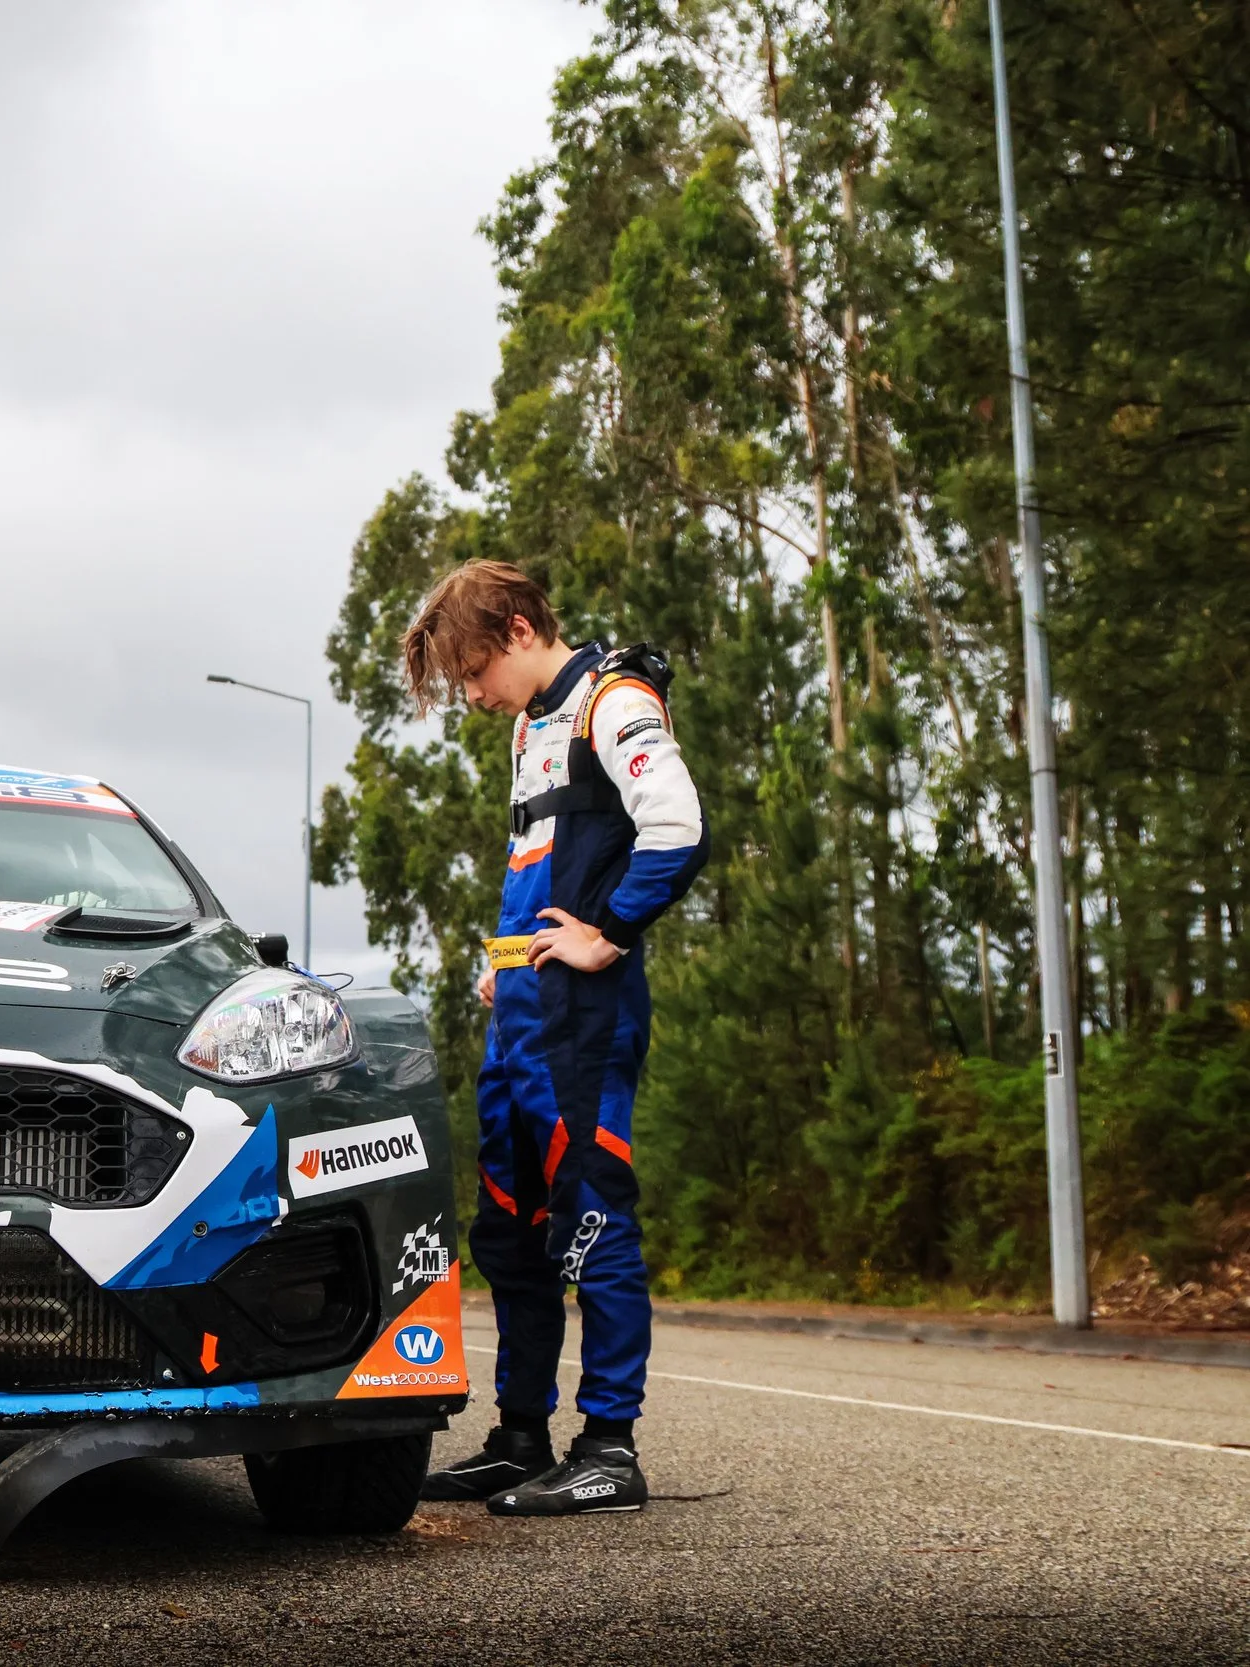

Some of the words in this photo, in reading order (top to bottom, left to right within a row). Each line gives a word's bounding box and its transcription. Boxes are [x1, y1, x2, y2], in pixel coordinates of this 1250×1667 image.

[321, 1132, 419, 1176] HANKOOK
[560, 1210, 607, 1281] parco
[422, 1251, 440, 1272] M
[423, 1274, 449, 1282] POLAND
[401, 1329, 441, 1359] W
[353, 1372, 459, 1386] West2000.se
[572, 1483, 616, 1500] sparco
